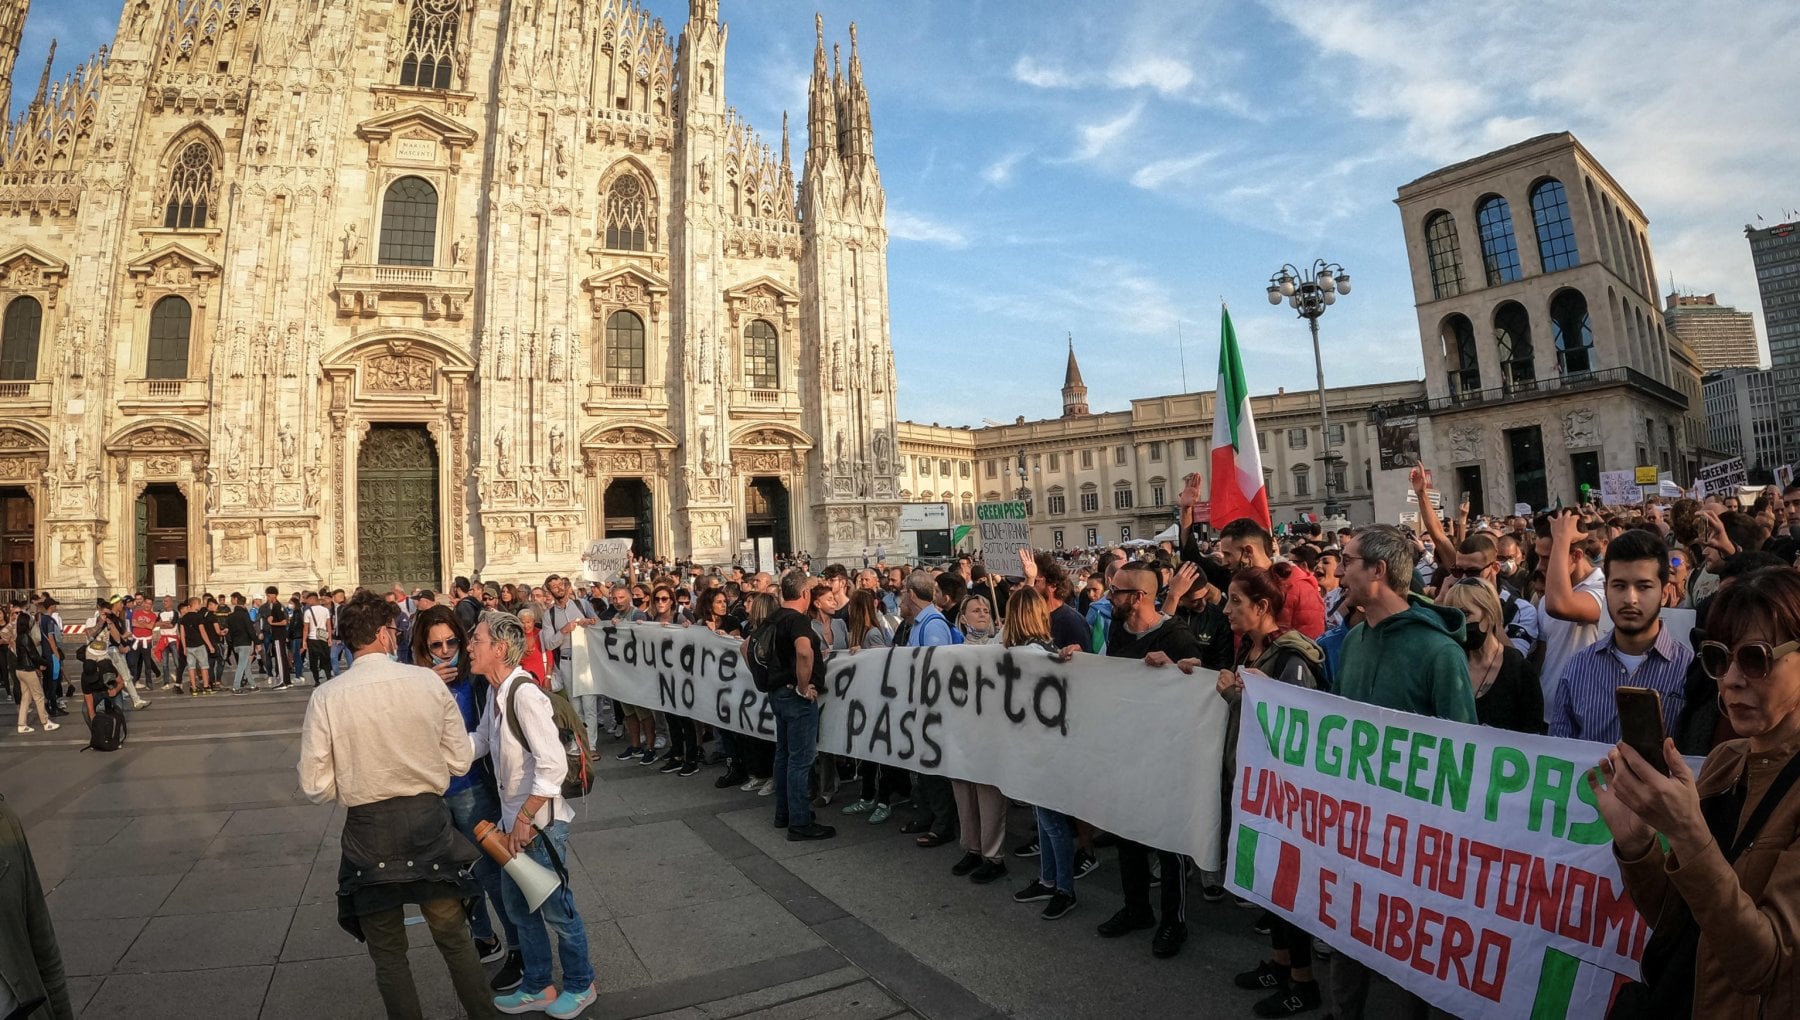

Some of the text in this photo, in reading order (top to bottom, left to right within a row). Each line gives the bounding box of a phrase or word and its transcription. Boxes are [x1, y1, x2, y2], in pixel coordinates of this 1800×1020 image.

[977, 502, 1026, 520] GREEN PASS
[588, 557, 627, 572] REMBAMBIT
[591, 543, 623, 556] DRAGHI
[603, 626, 738, 682] Educare
[659, 672, 695, 709] NO
[846, 699, 942, 769] PASS
[1257, 702, 1671, 854] NO GREEN PAS
[1319, 867, 1512, 1003] E LIBERO
